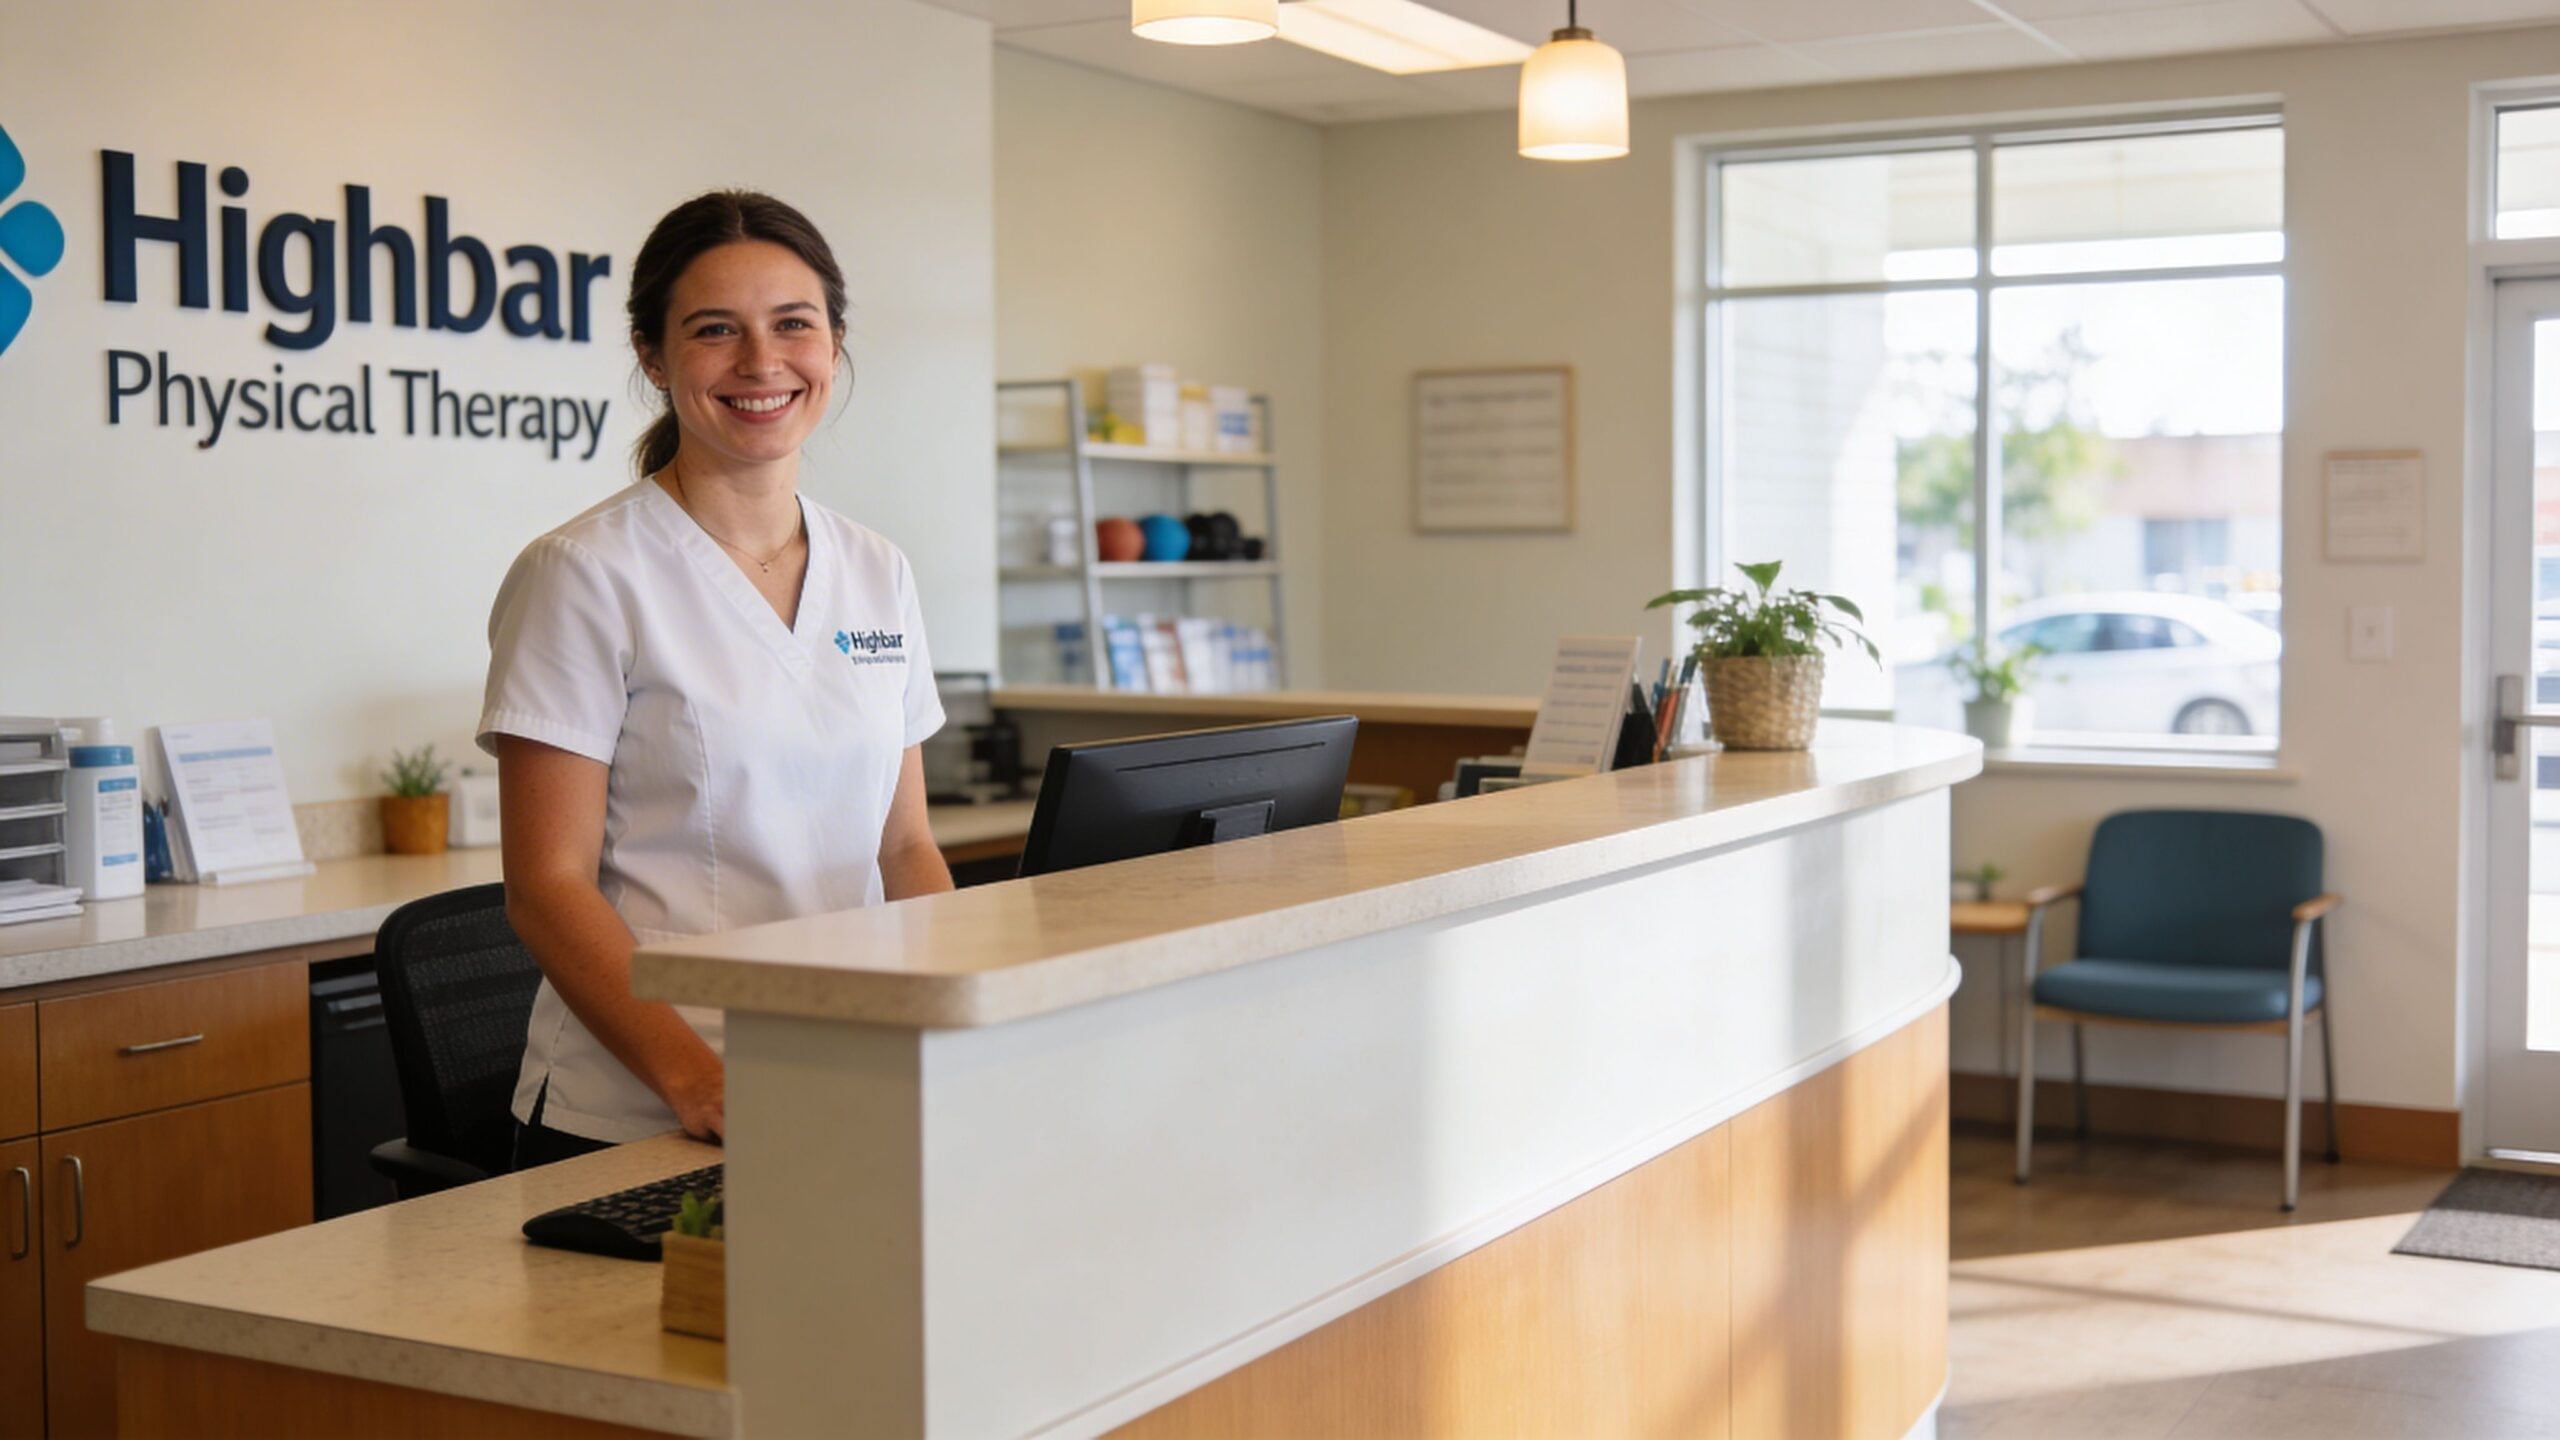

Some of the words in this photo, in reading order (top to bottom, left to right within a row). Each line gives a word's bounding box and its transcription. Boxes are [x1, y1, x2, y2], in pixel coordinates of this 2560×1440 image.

[100, 149, 611, 351] Highbar
[106, 348, 376, 451] Physical
[388, 367, 609, 461] Therapy
[851, 629, 903, 653] Highbar
